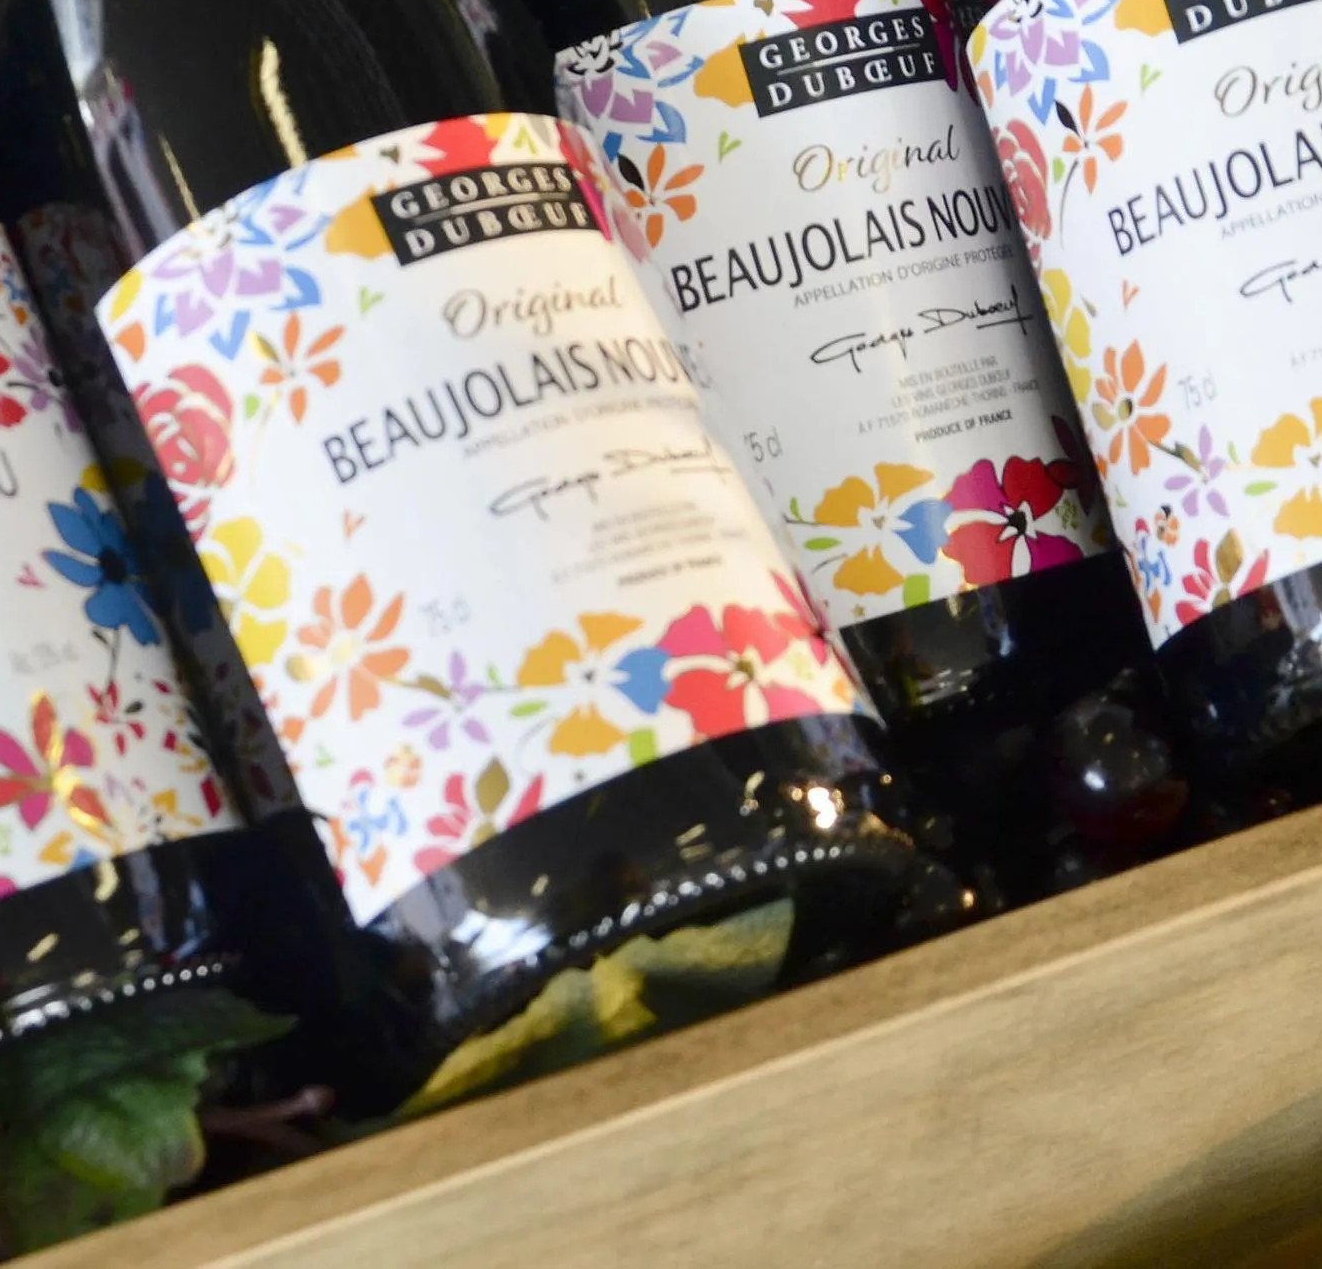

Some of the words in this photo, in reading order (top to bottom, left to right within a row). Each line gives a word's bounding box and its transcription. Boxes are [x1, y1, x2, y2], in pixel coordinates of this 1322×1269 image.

[759, 15, 925, 70] GEORGES
[793, 124, 960, 194] Original
[390, 167, 573, 220] GEORGES
[671, 200, 926, 313] BEAUJOLAIS
[441, 275, 623, 339] Original
[793, 269, 893, 309] APPELLATION
[323, 341, 600, 484] BEAUJOLAIS
